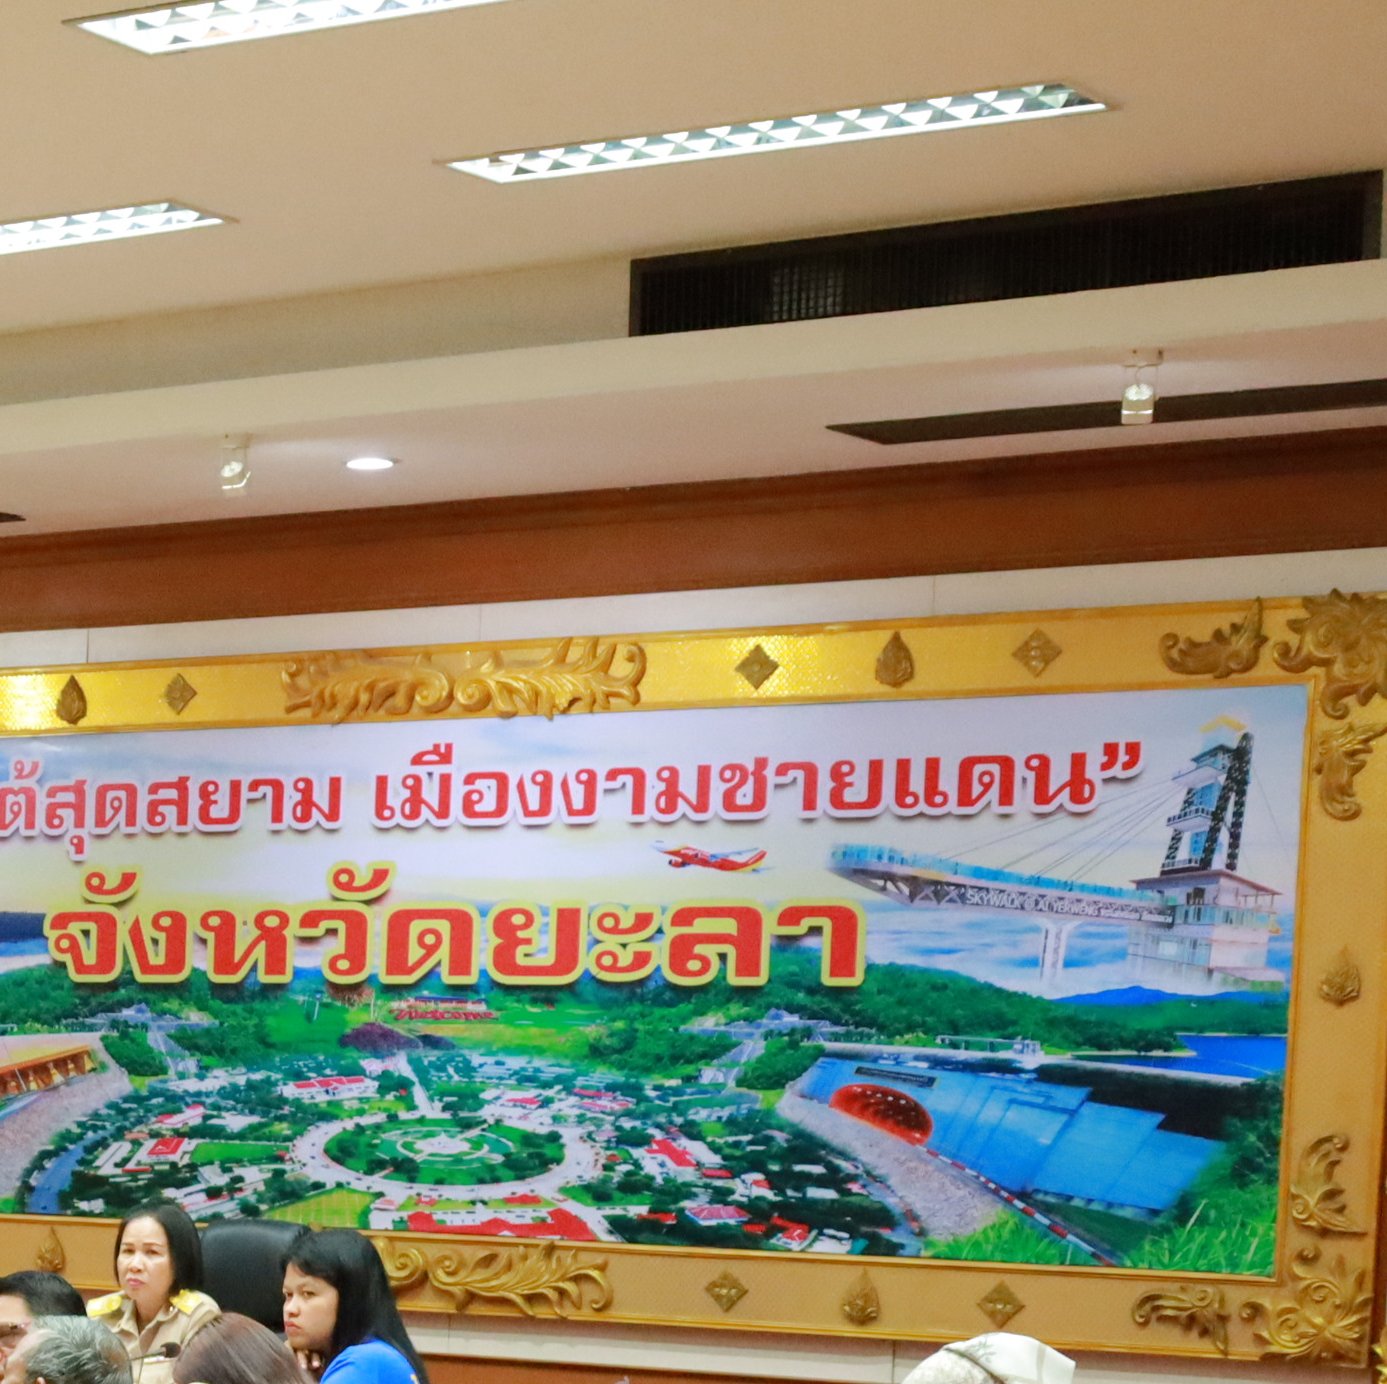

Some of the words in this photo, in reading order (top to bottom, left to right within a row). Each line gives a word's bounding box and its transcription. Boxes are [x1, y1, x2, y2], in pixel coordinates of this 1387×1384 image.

[372, 741, 1143, 822] เมืองงามชายแดน”
[46, 863, 864, 984] จังหวัดยะลา
[966, 886, 1023, 910] SKYWALK
